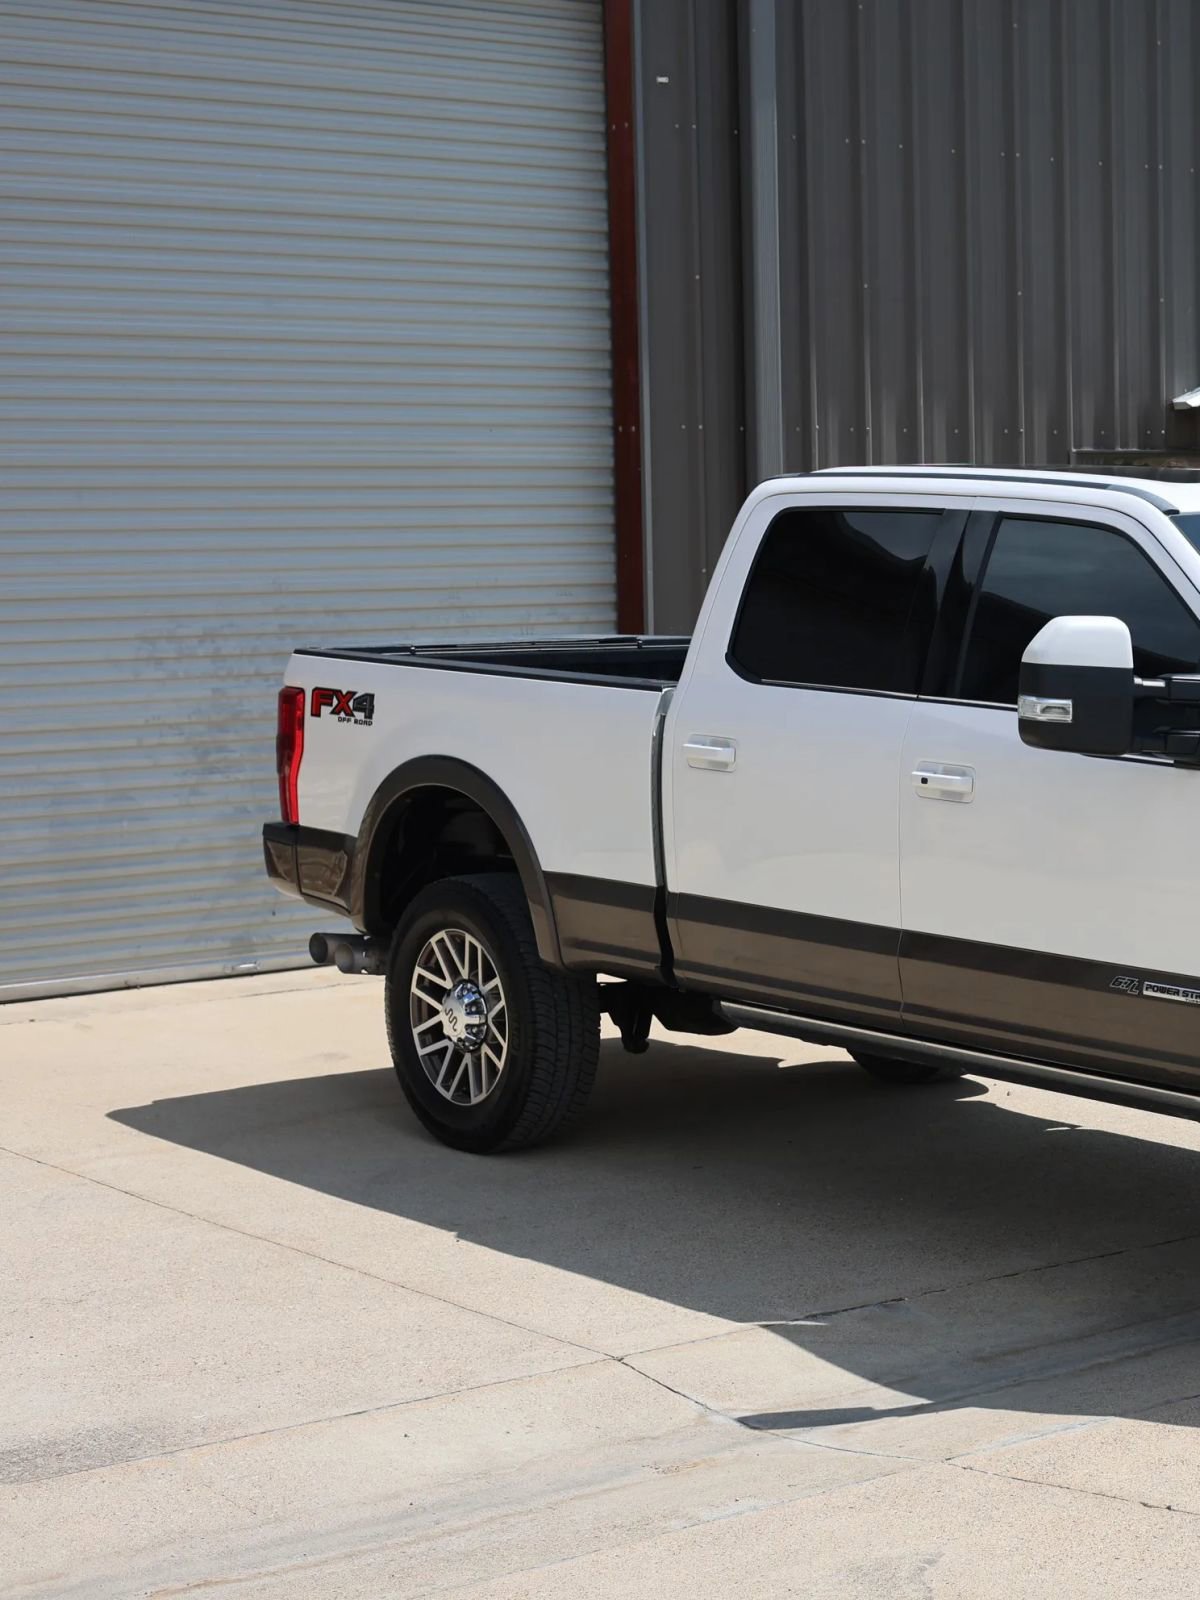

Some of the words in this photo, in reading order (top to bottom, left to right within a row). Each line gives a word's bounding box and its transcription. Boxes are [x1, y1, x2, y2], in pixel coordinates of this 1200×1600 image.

[310, 686, 375, 720] FX4
[337, 716, 352, 724] OFF
[353, 718, 373, 726] ROAD
[1145, 983, 1180, 997] POWER
